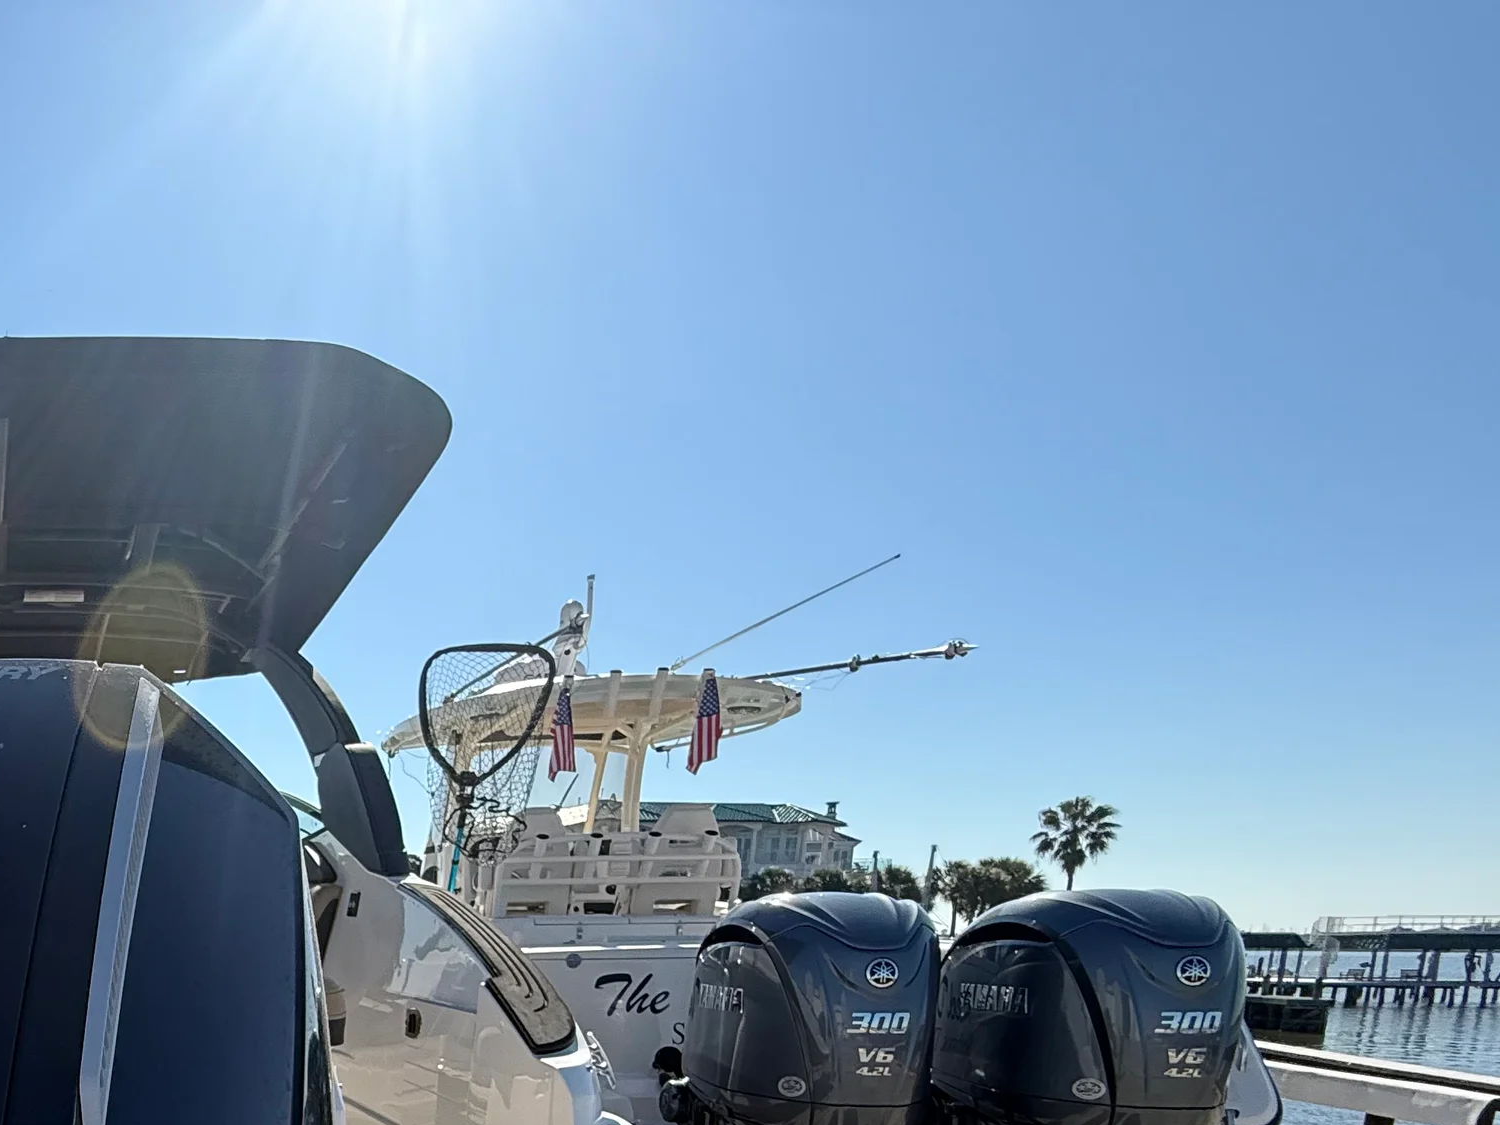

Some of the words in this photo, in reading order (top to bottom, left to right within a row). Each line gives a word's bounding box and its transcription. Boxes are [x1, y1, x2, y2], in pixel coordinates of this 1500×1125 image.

[594, 972, 671, 1017] The
[846, 1012, 911, 1034] 300
[1154, 1011, 1223, 1034] 300
[858, 1047, 896, 1063] V6
[1167, 1047, 1208, 1065] V6
[855, 1066, 893, 1077] 4.2L
[1163, 1067, 1203, 1078] 4.2L
